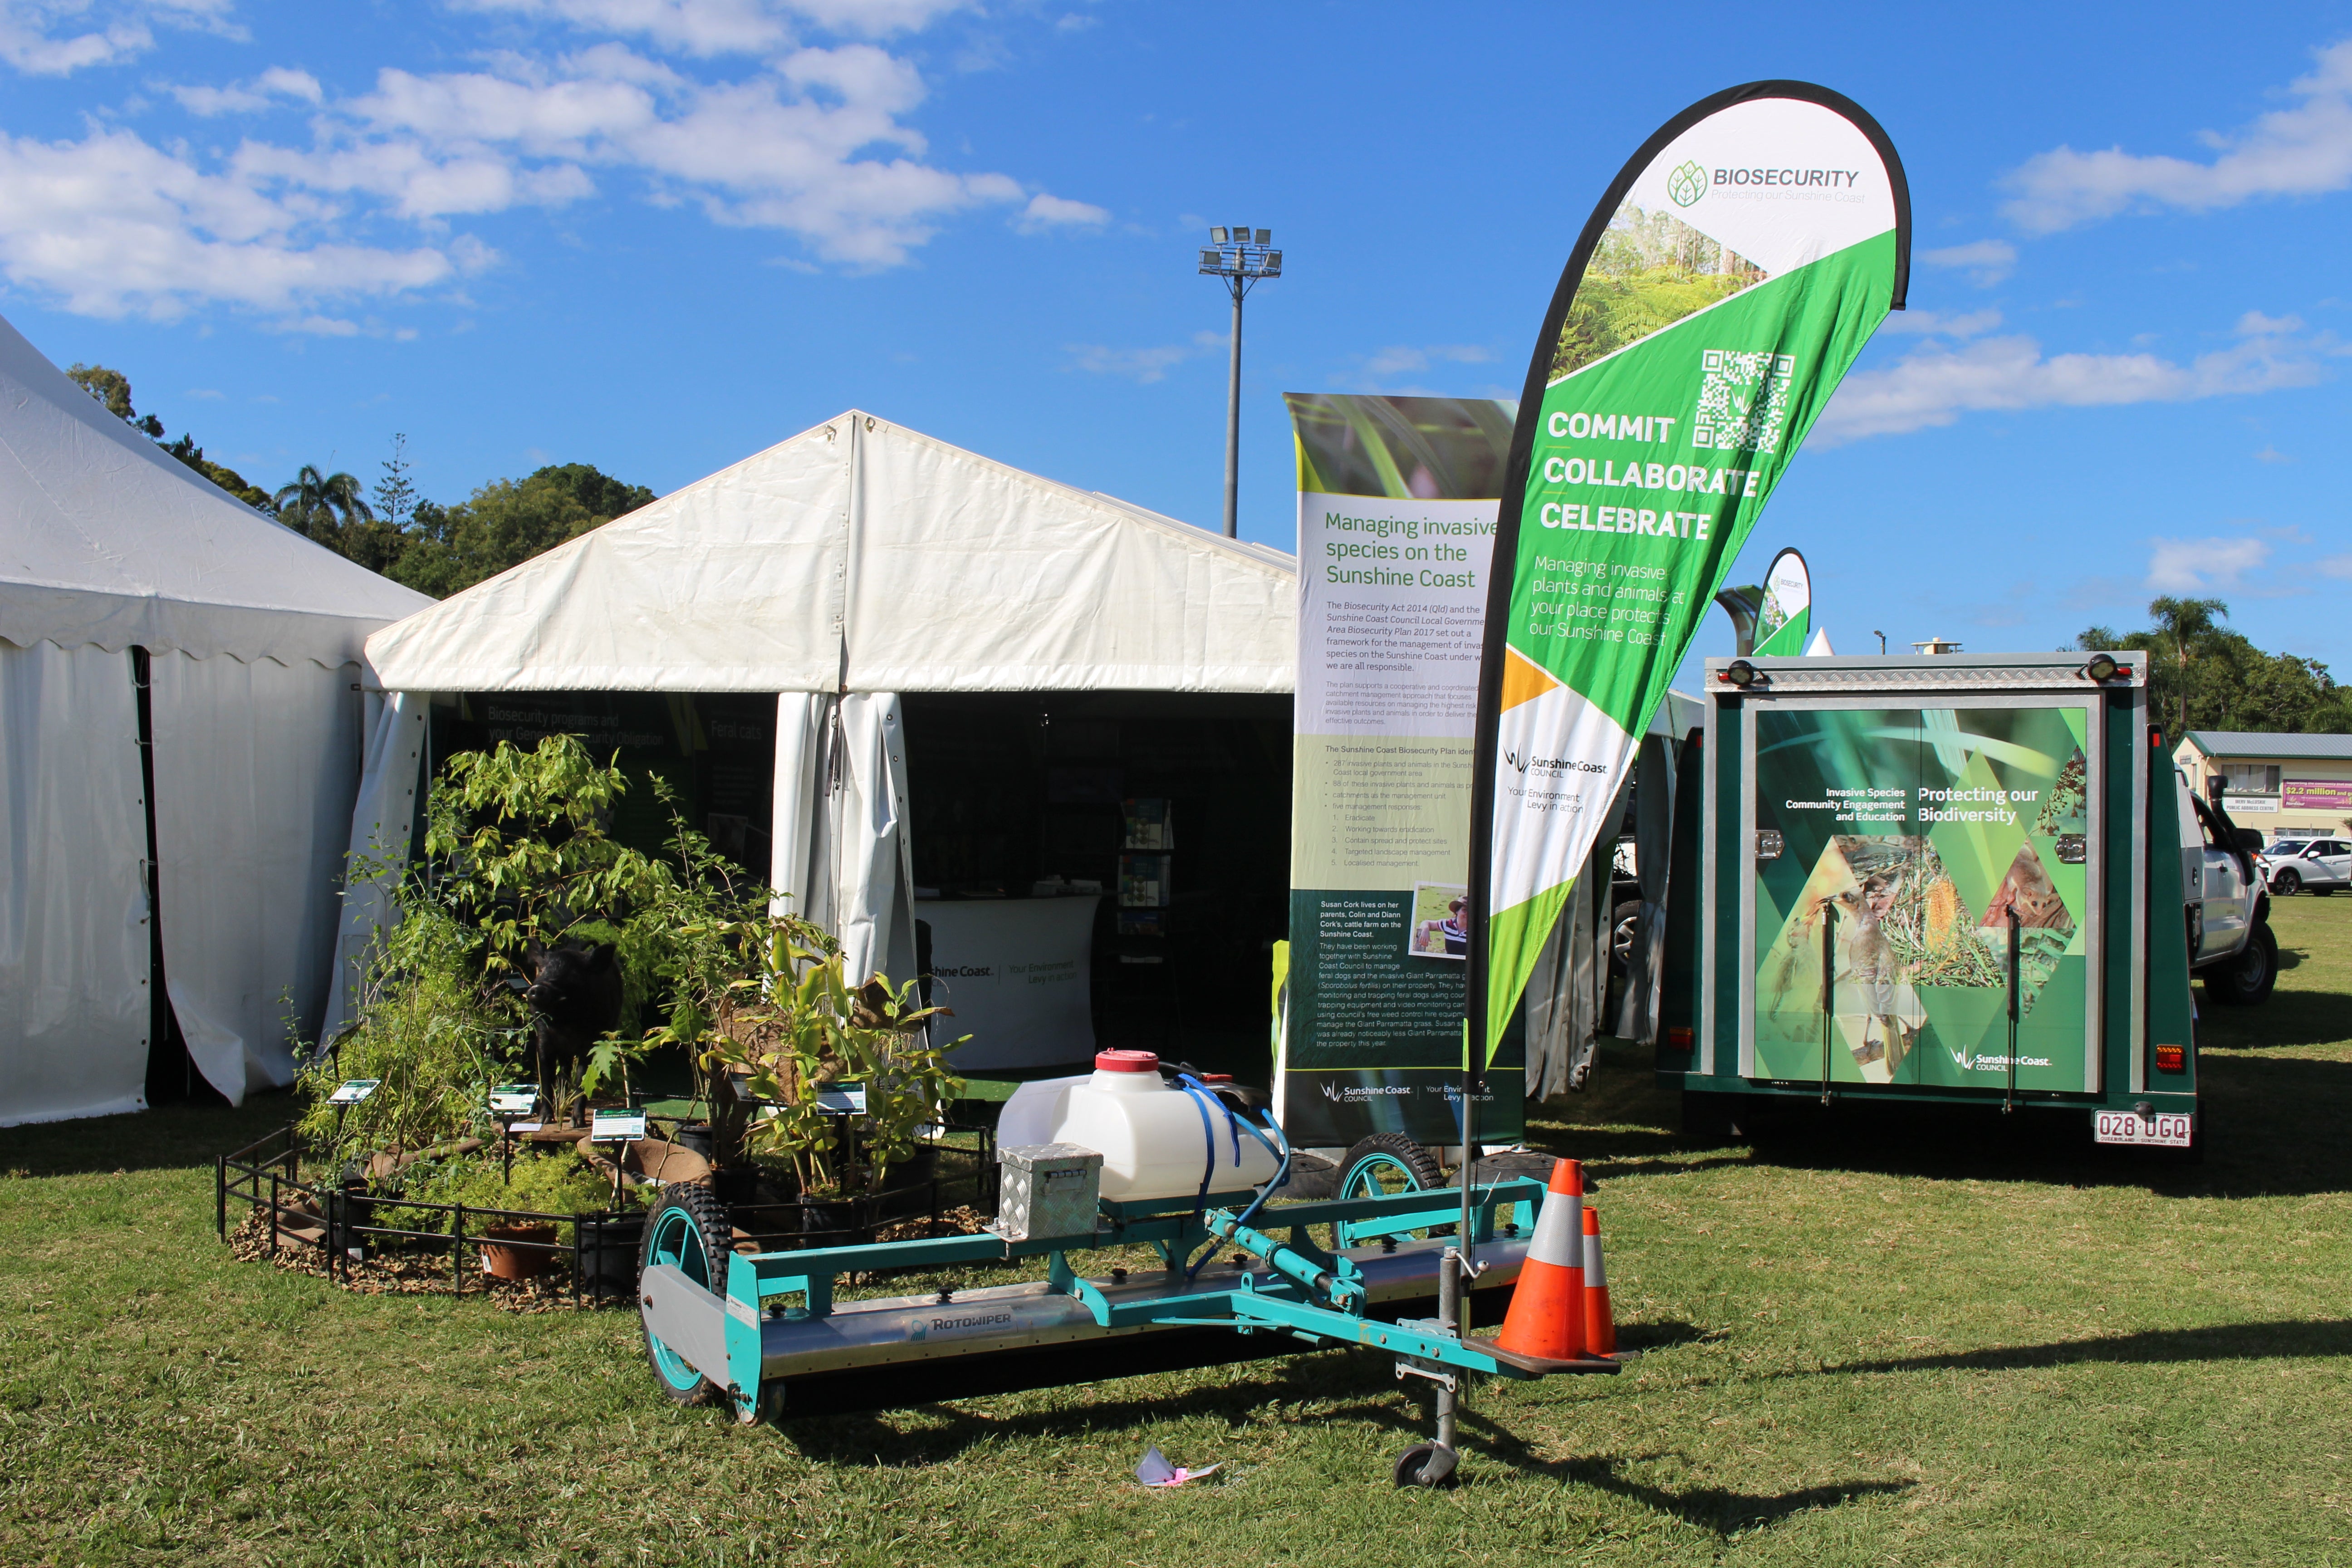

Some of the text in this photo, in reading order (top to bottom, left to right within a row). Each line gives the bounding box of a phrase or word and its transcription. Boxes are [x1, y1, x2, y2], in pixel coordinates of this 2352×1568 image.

[1713, 169, 1859, 187] BIOSECURITY
[1711, 189, 1763, 201] Protecting
[1785, 190, 1832, 201] Sunshine
[1834, 191, 1865, 204] Coast
[1548, 412, 1675, 443] COMMIT
[1544, 457, 1760, 497] COLLABORATE
[1326, 512, 1418, 539] Managing
[1540, 503, 1711, 540] CELEBRATE
[1327, 541, 1467, 561] species on the
[1535, 556, 1665, 580] Managing invasive
[1327, 566, 1475, 587] Sunshine Coast
[1781, 578, 1803, 589] BIOSECURITY
[1532, 578, 1685, 604] plants and animals at
[1344, 602, 1389, 612] Biosecurity
[1392, 603, 1405, 612] Act
[1407, 604, 1427, 612] 2014
[1429, 605, 1448, 614] (Qld)
[1531, 600, 1670, 625] your place protects
[1327, 614, 1363, 622] Sunshine
[1390, 616, 1420, 624] Council
[1445, 617, 1484, 626] Governme
[1348, 626, 1392, 637] Biosecurity
[1529, 622, 1666, 646] our Sunshine Coast
[1327, 638, 1369, 647] framework
[1384, 639, 1397, 647] the
[1400, 641, 1451, 650] management
[1327, 651, 1357, 659] species
[1367, 663, 1414, 673] responsible.
[488, 706, 618, 728] Biosecurity programs and
[1326, 745, 1338, 754] The
[1341, 746, 1374, 754] Sunshine
[1399, 747, 1438, 755] Biosecurity
[1532, 757, 1607, 774] Sunshine Coast
[1531, 768, 1564, 778] COUNCIL
[1508, 786, 1579, 802] Your Environment
[1826, 788, 1905, 799] Invasive Species
[1918, 787, 2038, 804] Protecting our
[1528, 800, 1583, 813] Levy in action
[1786, 800, 1905, 811] Community Engagement
[1836, 812, 1905, 821] and Education
[1918, 807, 2016, 826] Biodiversity
[960, 966, 990, 977] Coast
[1029, 960, 1074, 971] Environment
[1029, 975, 1046, 985] Levy
[1056, 971, 1077, 980] action
[1976, 1054, 2048, 1066] Sunshine Coast
[1344, 1086, 1410, 1095] Sunshine Coast
[1444, 1094, 1460, 1102] Levy
[2100, 1116, 2185, 1139] 028 UGQ
[931, 1314, 1011, 1330] ROTOWIPER
